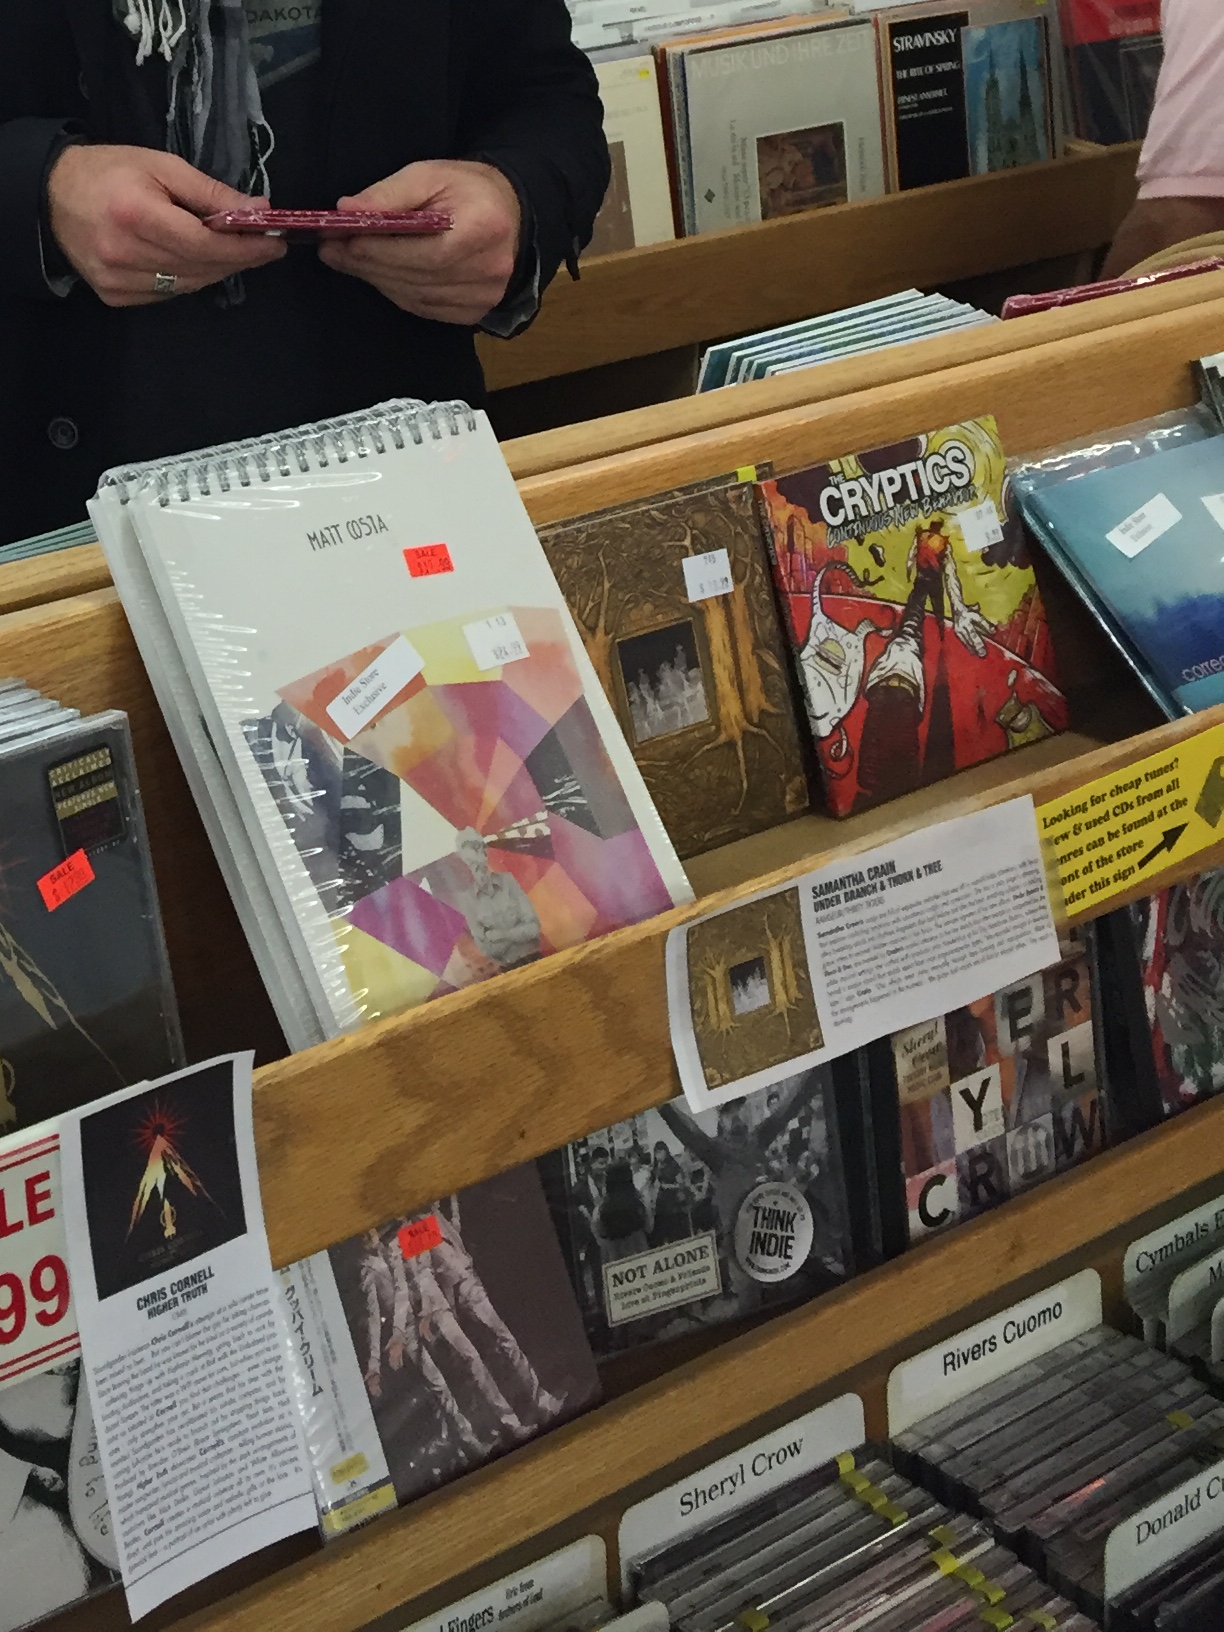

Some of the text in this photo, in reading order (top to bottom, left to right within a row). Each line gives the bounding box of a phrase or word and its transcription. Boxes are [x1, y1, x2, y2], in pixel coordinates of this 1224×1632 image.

[893, 28, 958, 53] STRAVINSKY
[691, 53, 747, 78] MUSIK
[750, 44, 789, 68] UND
[819, 437, 977, 528] CRYPTICS
[828, 473, 846, 486] THE
[306, 514, 389, 551] MATT COSTA
[340, 668, 380, 707] Indie Store
[352, 681, 387, 717] Exclusive
[1042, 757, 1180, 830] Looking for cheap tunes?
[1072, 777, 1180, 837] & used CDs from all
[1085, 796, 1189, 853] can be found at the
[48, 863, 75, 885] SALE
[1082, 860, 1094, 877] of
[1095, 854, 1115, 872] the
[1115, 838, 1145, 859] store
[811, 859, 897, 900] SAMANTHA CRAIN
[813, 894, 842, 913] UNDER
[844, 882, 879, 906] BRANCH
[888, 868, 914, 889] THORN
[923, 859, 943, 876] TREE
[1088, 864, 1137, 896] this sign
[752, 1205, 798, 1234] THINK
[749, 1230, 796, 1261] INDIE
[1135, 1217, 1210, 1276] Cymbals
[611, 1263, 648, 1288] NOT
[652, 1244, 710, 1276] ALONE
[136, 1265, 215, 1312] CHRIS CORNELL
[147, 1282, 209, 1320] HIGHER TRUTH
[941, 1299, 1065, 1377] Rivers Cuomo
[679, 1435, 805, 1517] Sheryl Crow
[1135, 1487, 1202, 1546] Donald
